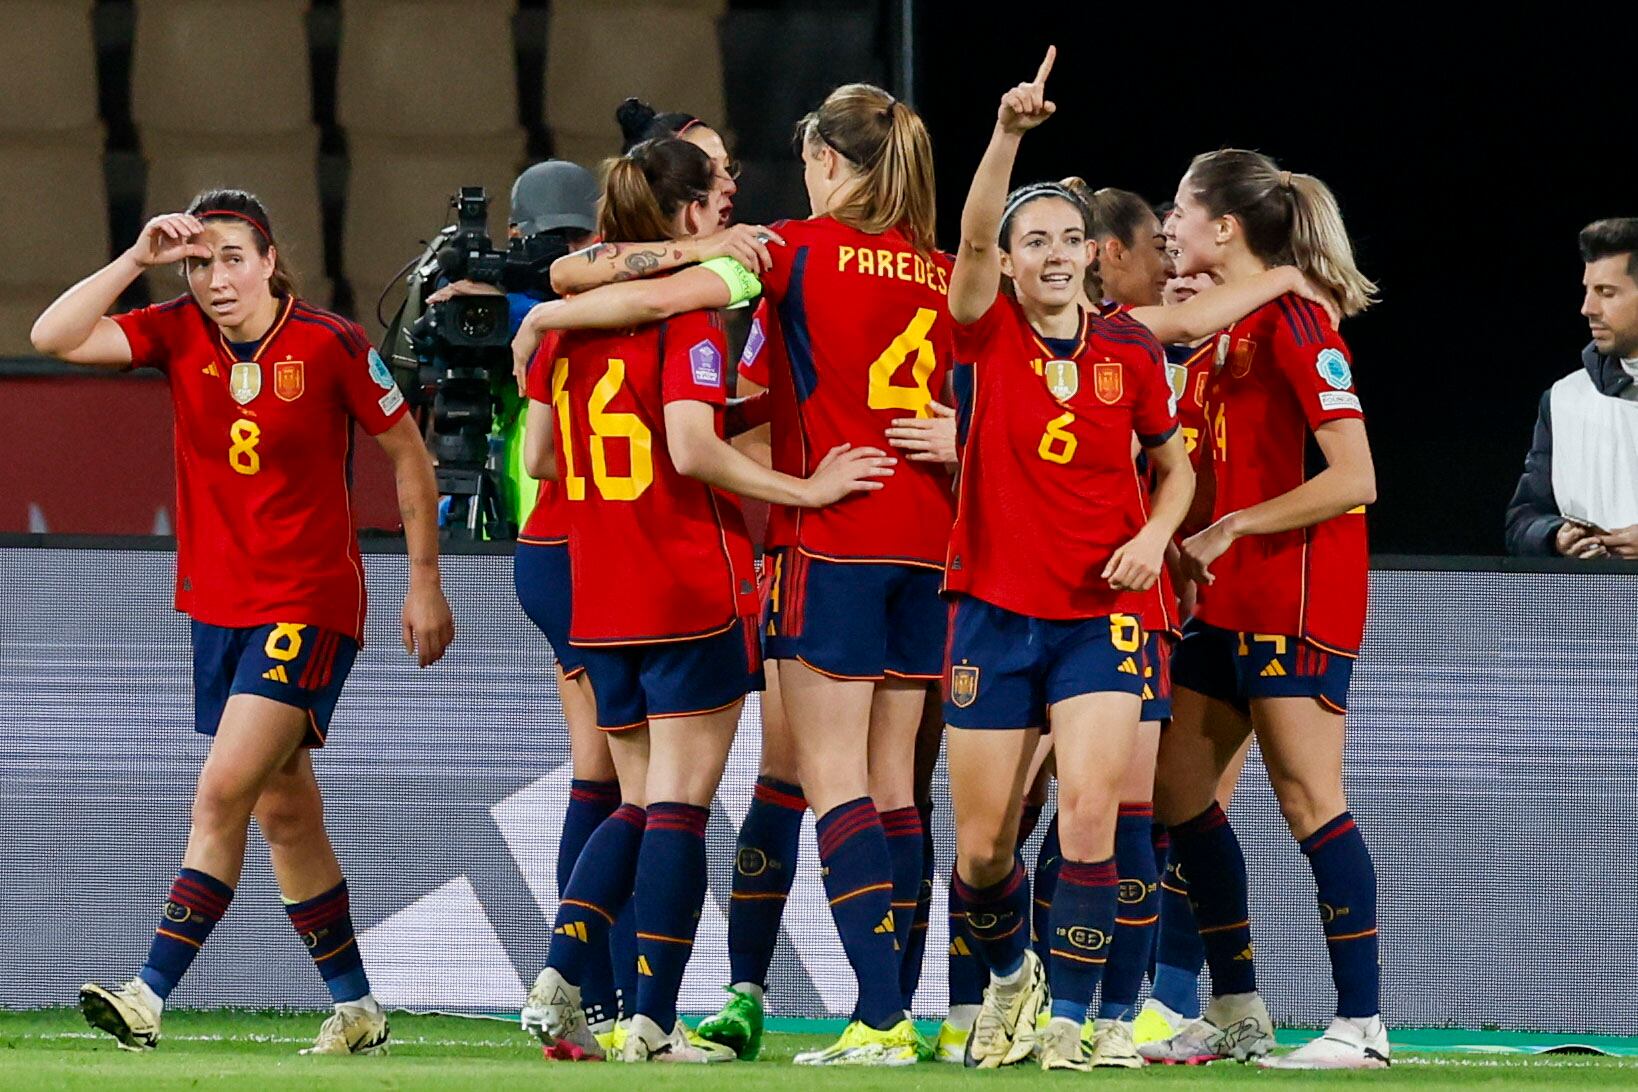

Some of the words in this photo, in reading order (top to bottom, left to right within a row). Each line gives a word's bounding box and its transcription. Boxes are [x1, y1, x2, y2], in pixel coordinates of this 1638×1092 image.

[838, 245, 947, 296] PAREDES
[868, 307, 938, 420] 4
[229, 418, 261, 475] 8
[552, 358, 654, 501] 16
[1038, 411, 1078, 465] 6
[264, 622, 308, 662] 8
